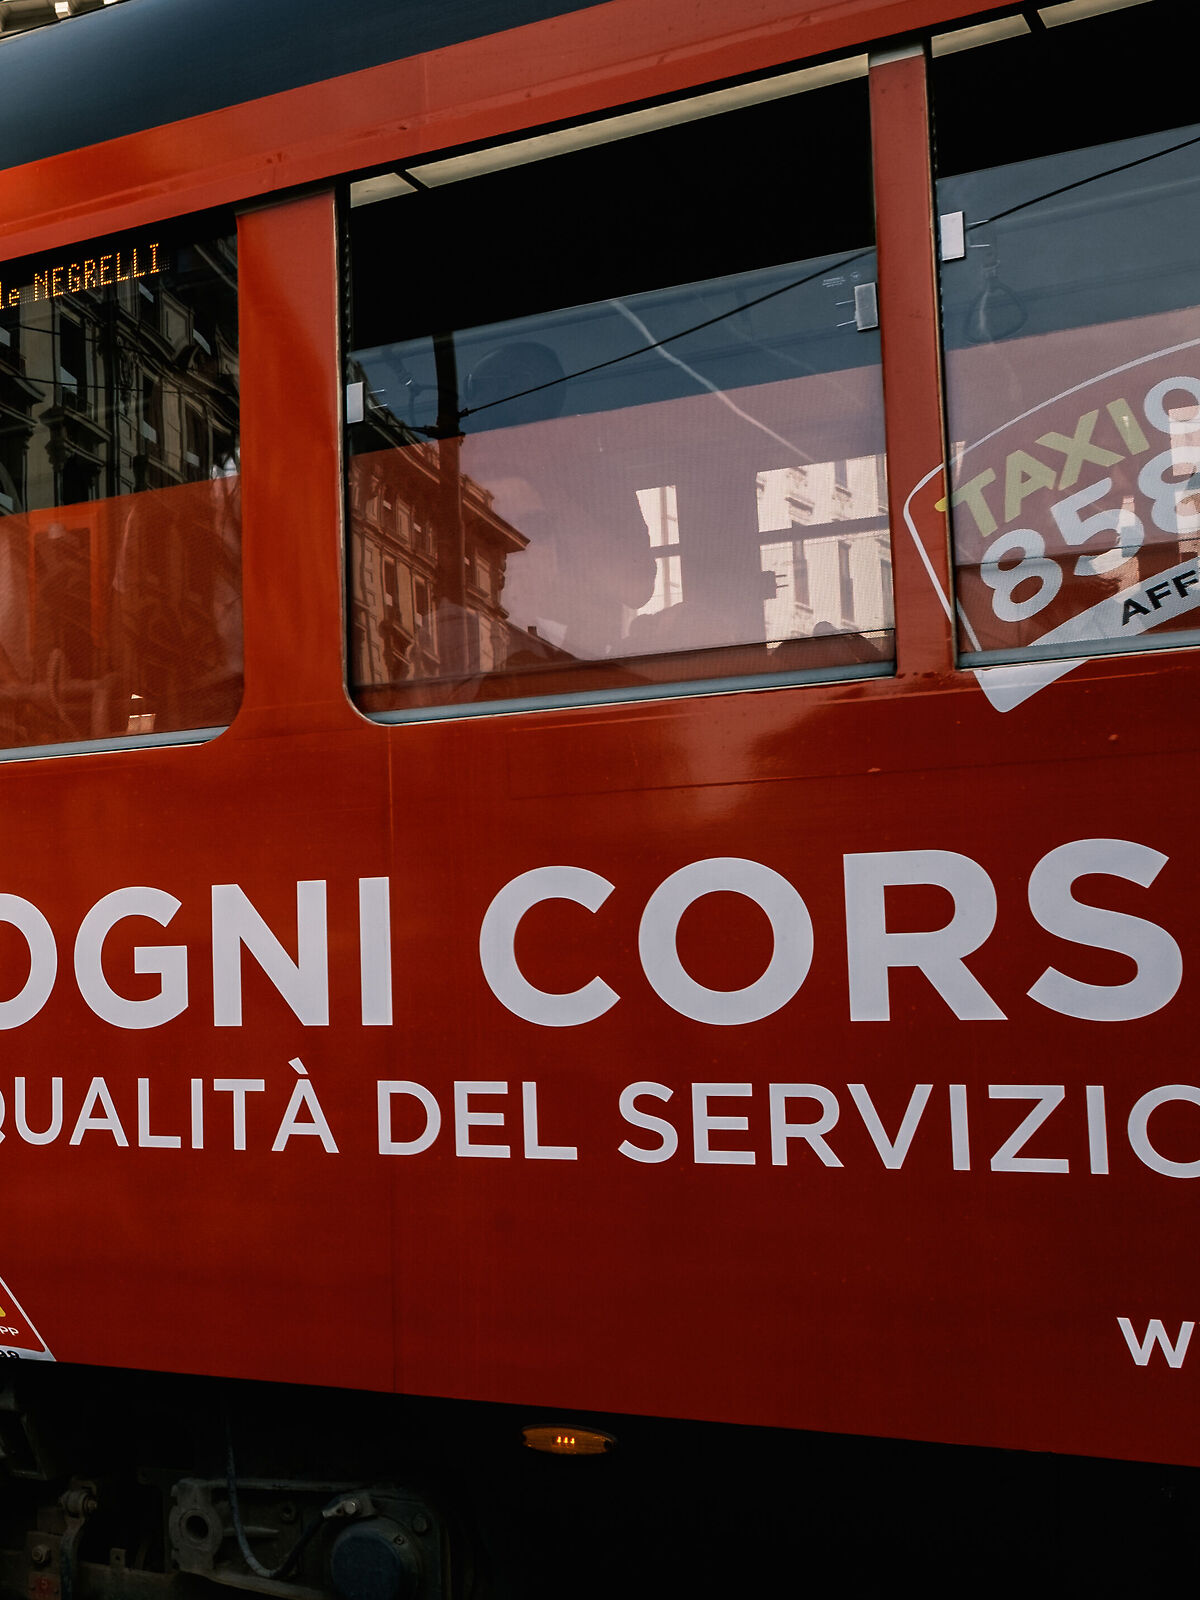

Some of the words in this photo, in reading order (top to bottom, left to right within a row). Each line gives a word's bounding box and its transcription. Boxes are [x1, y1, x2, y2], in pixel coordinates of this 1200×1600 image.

[34, 243, 160, 302] NEGRELLI
[1121, 568, 1200, 627] AFF
[480, 839, 1183, 1027] CORS
[378, 1081, 577, 1161] DEL
[619, 1082, 1200, 1179] SERVIZIO
